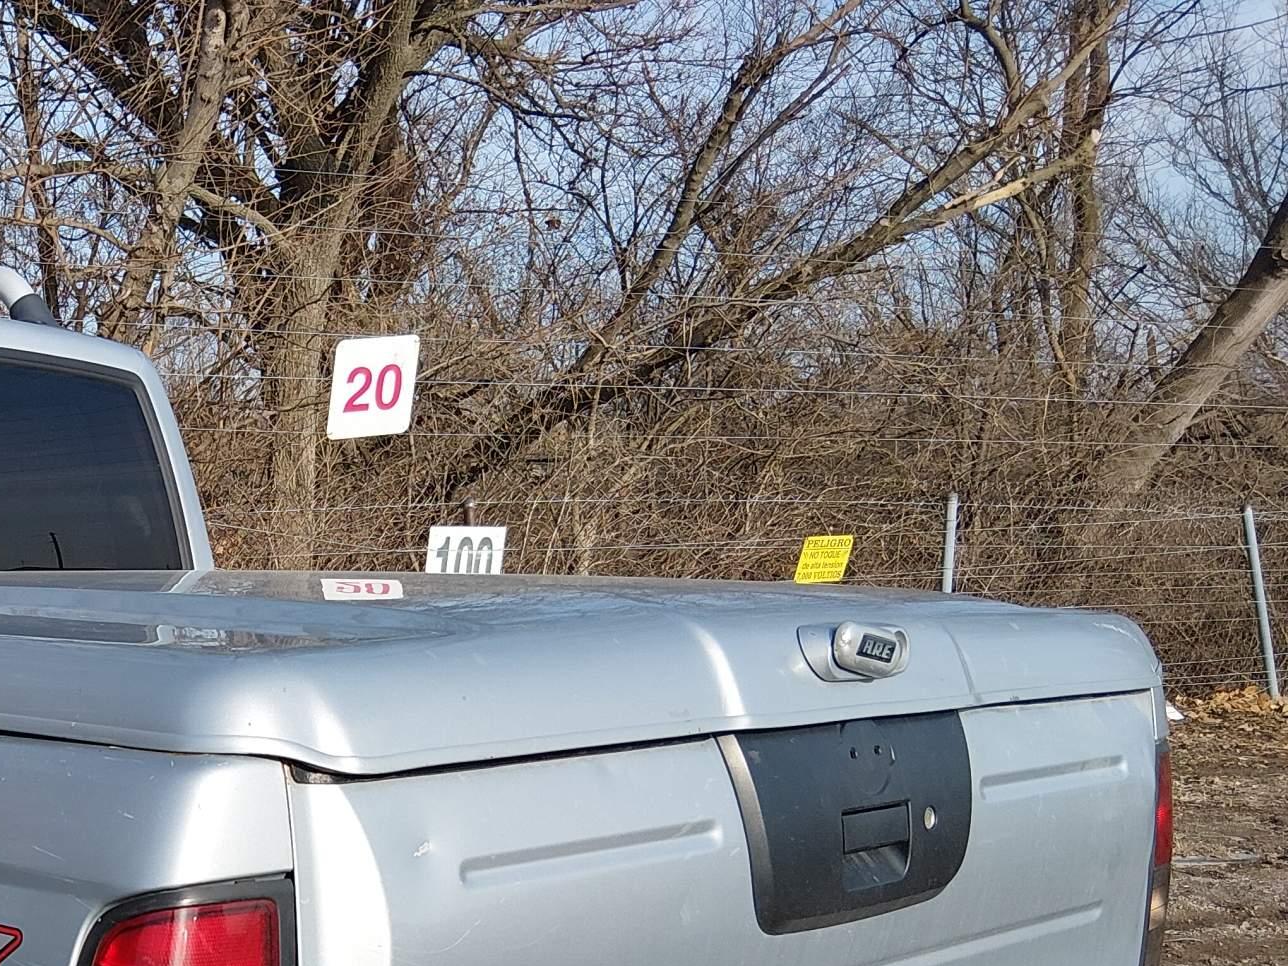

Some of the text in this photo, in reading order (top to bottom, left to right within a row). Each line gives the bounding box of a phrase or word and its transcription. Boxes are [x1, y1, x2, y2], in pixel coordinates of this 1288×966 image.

[342, 363, 403, 414] 20
[806, 538, 852, 548] PELIGRO
[809, 550, 842, 560] NO TOQUE
[813, 570, 842, 580] VOLTIOS
[862, 639, 893, 659] ARE
